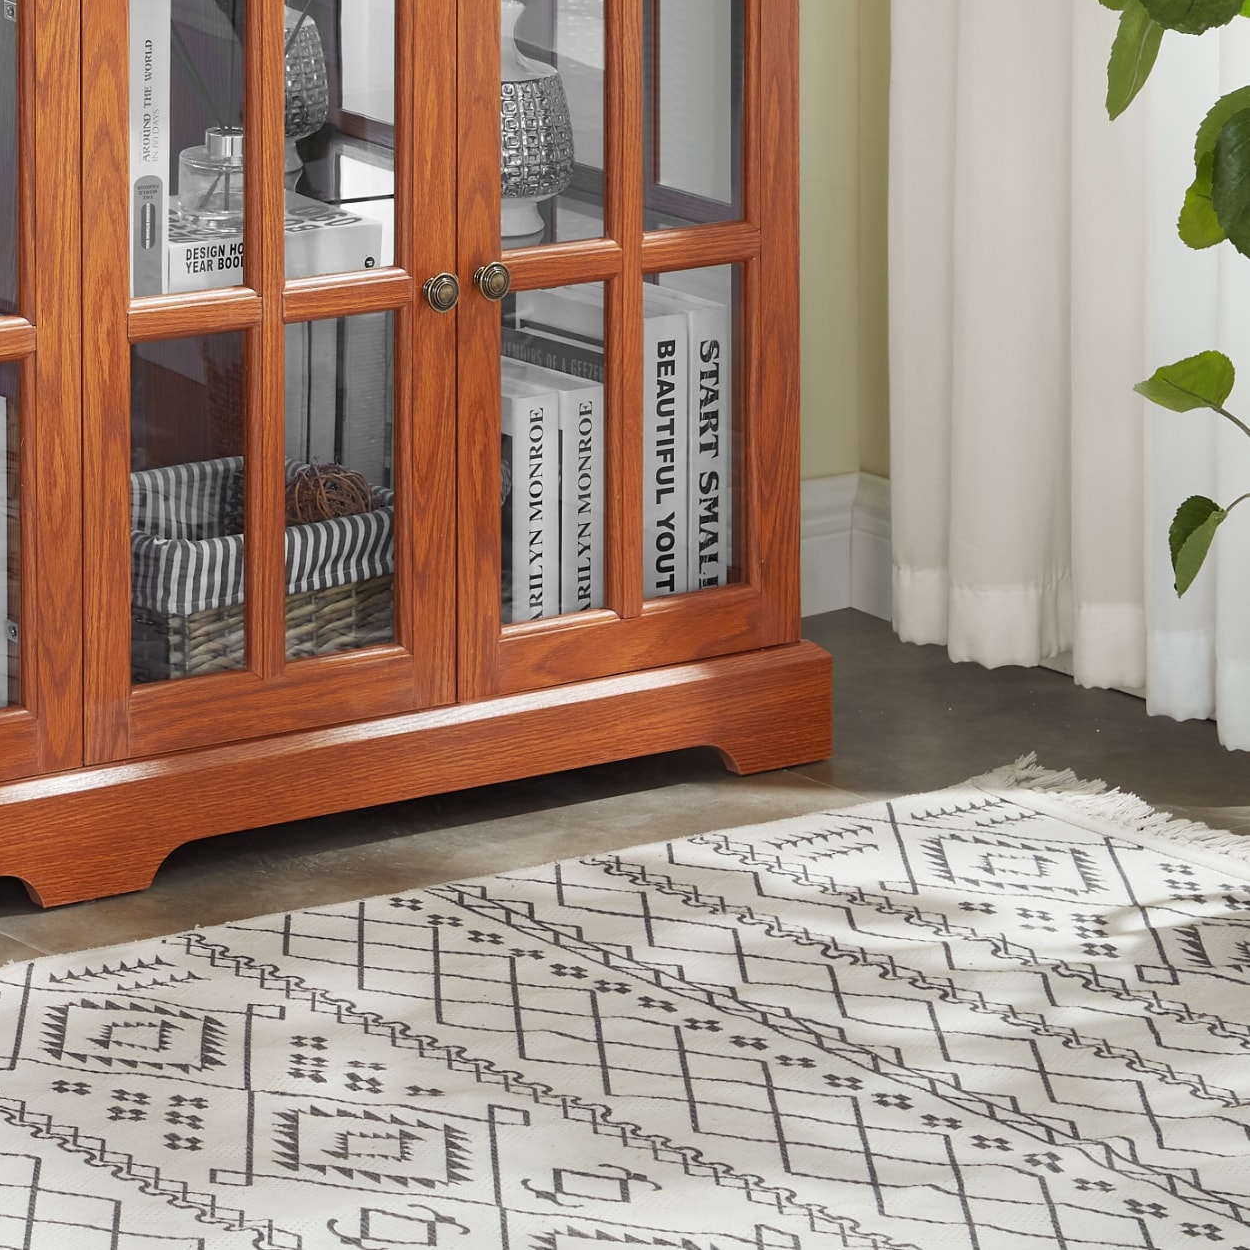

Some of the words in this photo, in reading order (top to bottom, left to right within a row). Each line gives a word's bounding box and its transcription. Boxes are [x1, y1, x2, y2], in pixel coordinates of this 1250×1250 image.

[144, 39, 153, 82] WORLD
[143, 86, 152, 109] THE
[142, 113, 151, 162] AROUND
[186, 244, 226, 261] DESIGN
[186, 259, 214, 274] YEAR
[217, 255, 244, 270] BOO
[655, 339, 676, 505] BEAUTIFUL
[699, 338, 720, 460] START
[529, 407, 544, 521] MONROE
[577, 400, 593, 516] MONROE
[655, 511, 676, 593] YOUT
